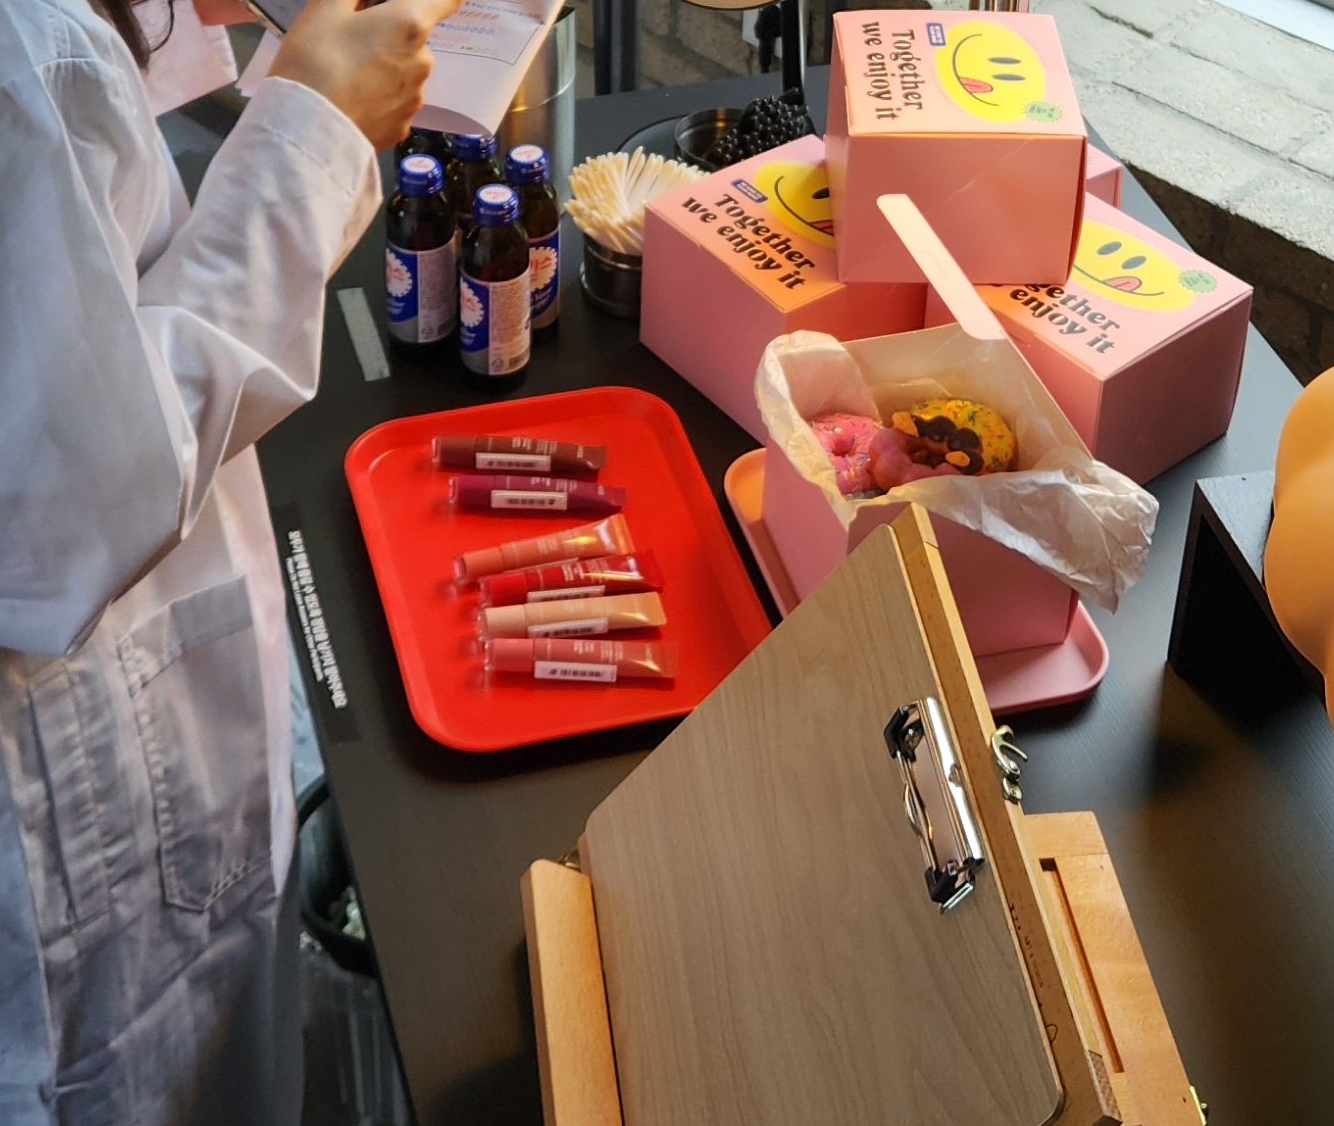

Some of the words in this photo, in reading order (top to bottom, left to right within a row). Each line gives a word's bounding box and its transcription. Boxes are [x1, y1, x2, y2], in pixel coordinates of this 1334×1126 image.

[861, 22, 882, 46] we
[863, 52, 896, 100] enjoy
[889, 29, 925, 110] Together
[875, 107, 902, 120] it
[681, 197, 718, 223] we
[716, 225, 783, 270] enjoy
[777, 270, 806, 289] it
[714, 194, 815, 269] Together
[1010, 288, 1087, 335] enjoy
[1086, 334, 1116, 354] it
[1023, 284, 1121, 331] gether
